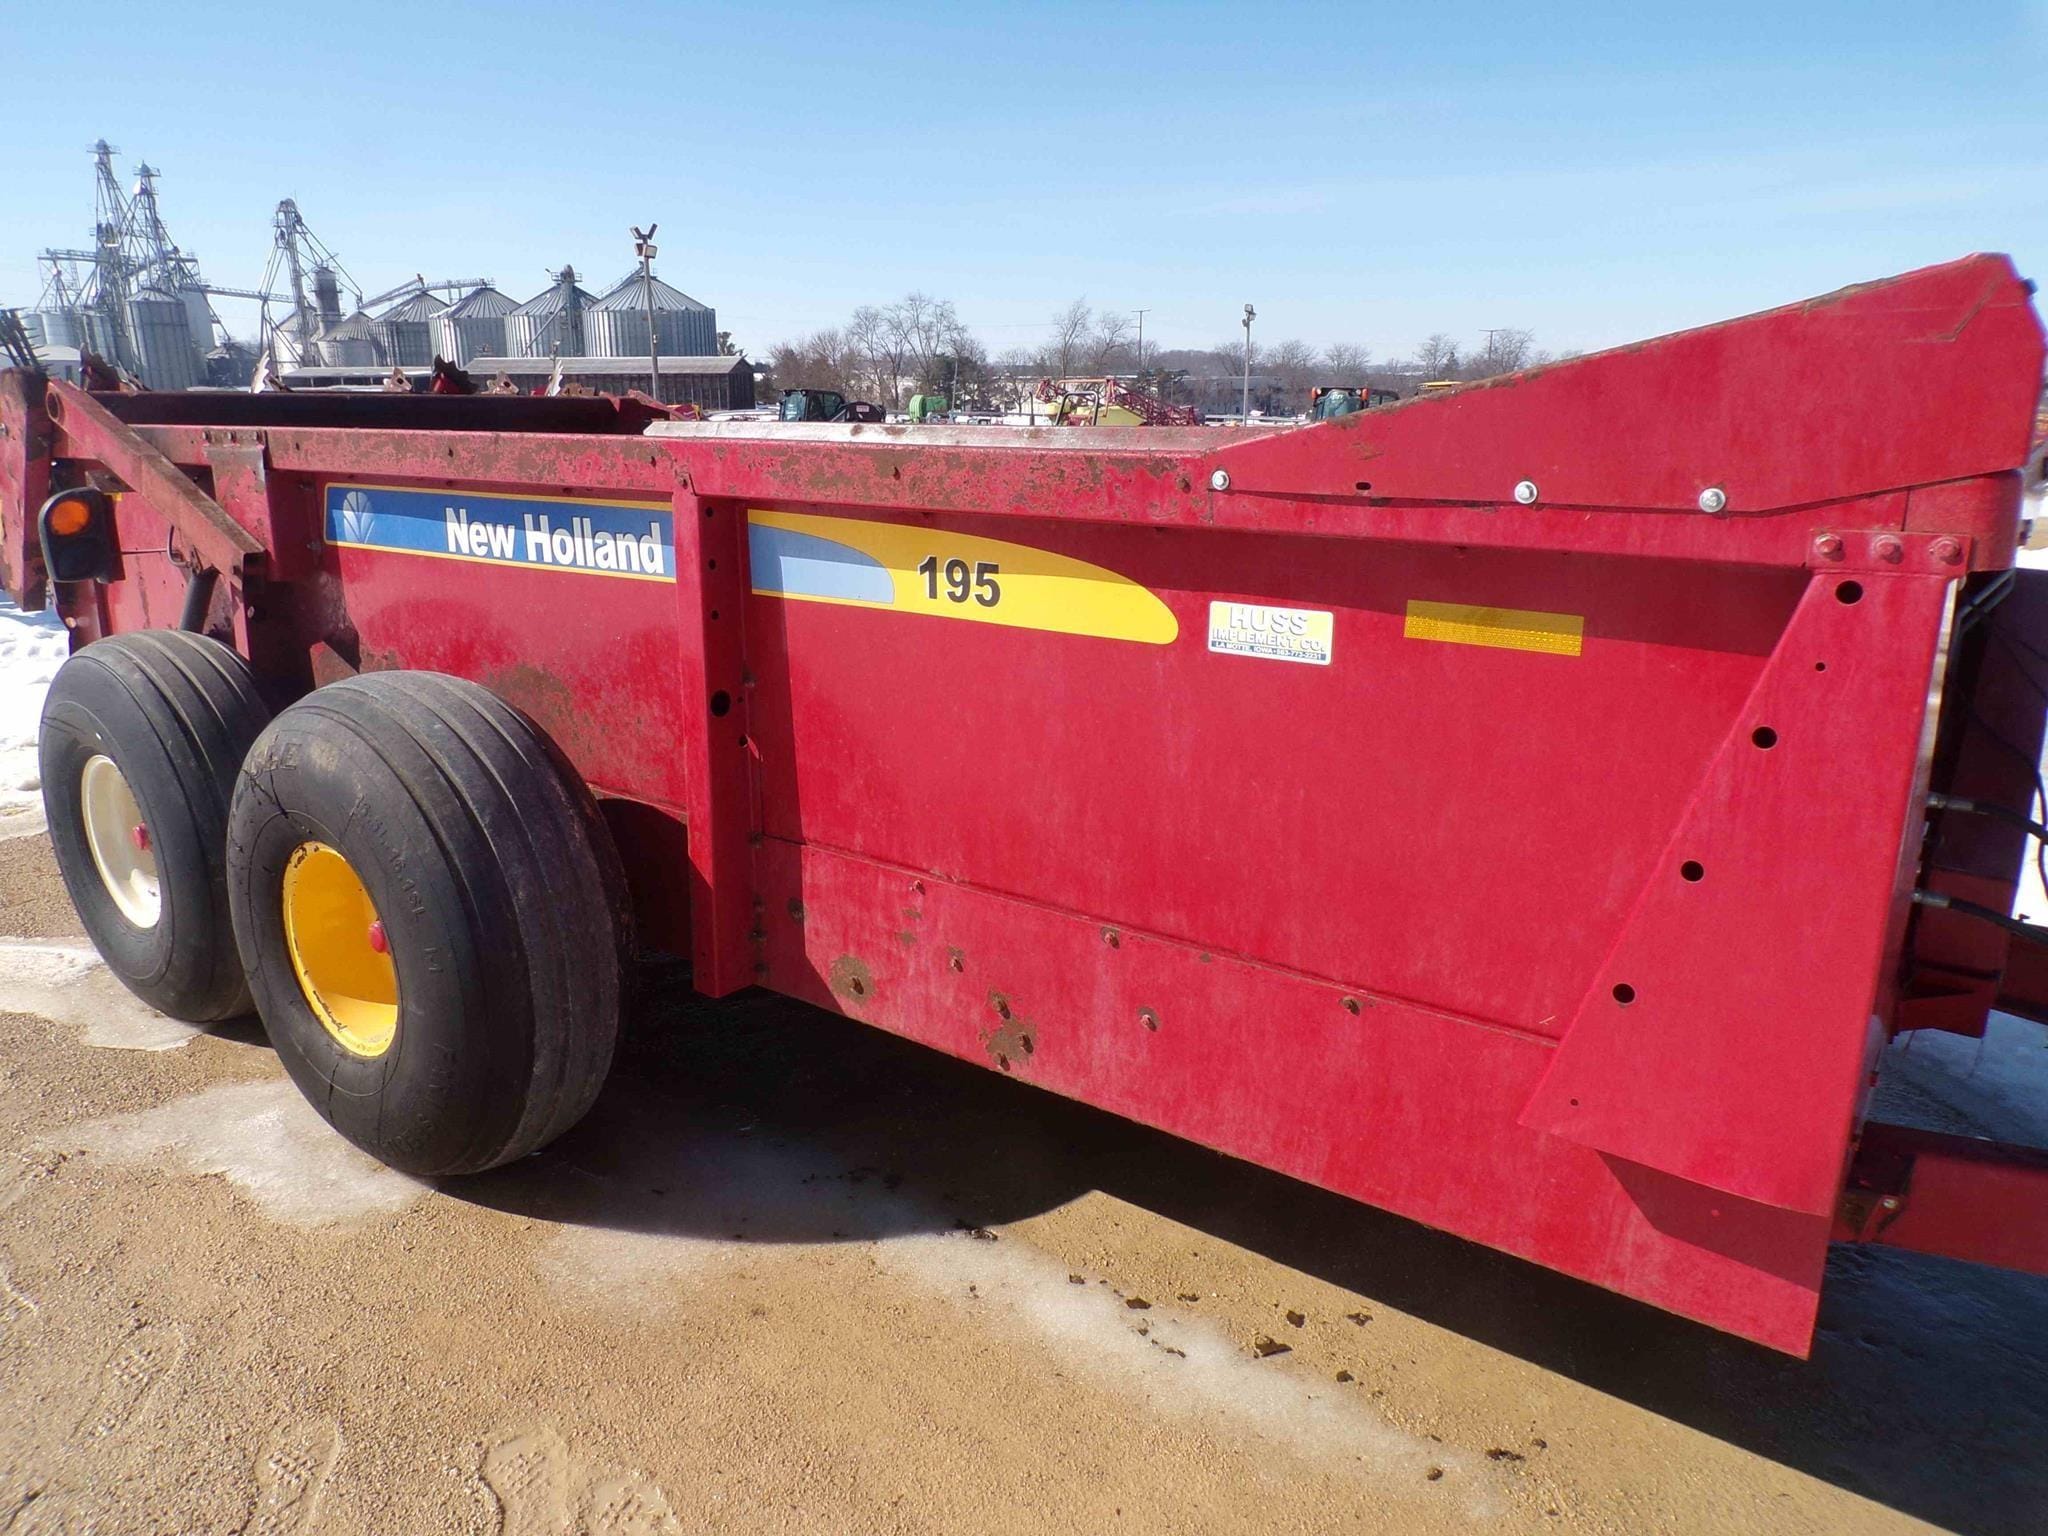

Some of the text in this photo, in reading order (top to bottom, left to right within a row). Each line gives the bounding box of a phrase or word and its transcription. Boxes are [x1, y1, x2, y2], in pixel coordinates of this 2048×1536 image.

[444, 507, 666, 575] New Holland
[918, 555, 1002, 608] 195
[1212, 627, 1297, 650] IMPLEMENT
[1230, 606, 1308, 635] HUSS
